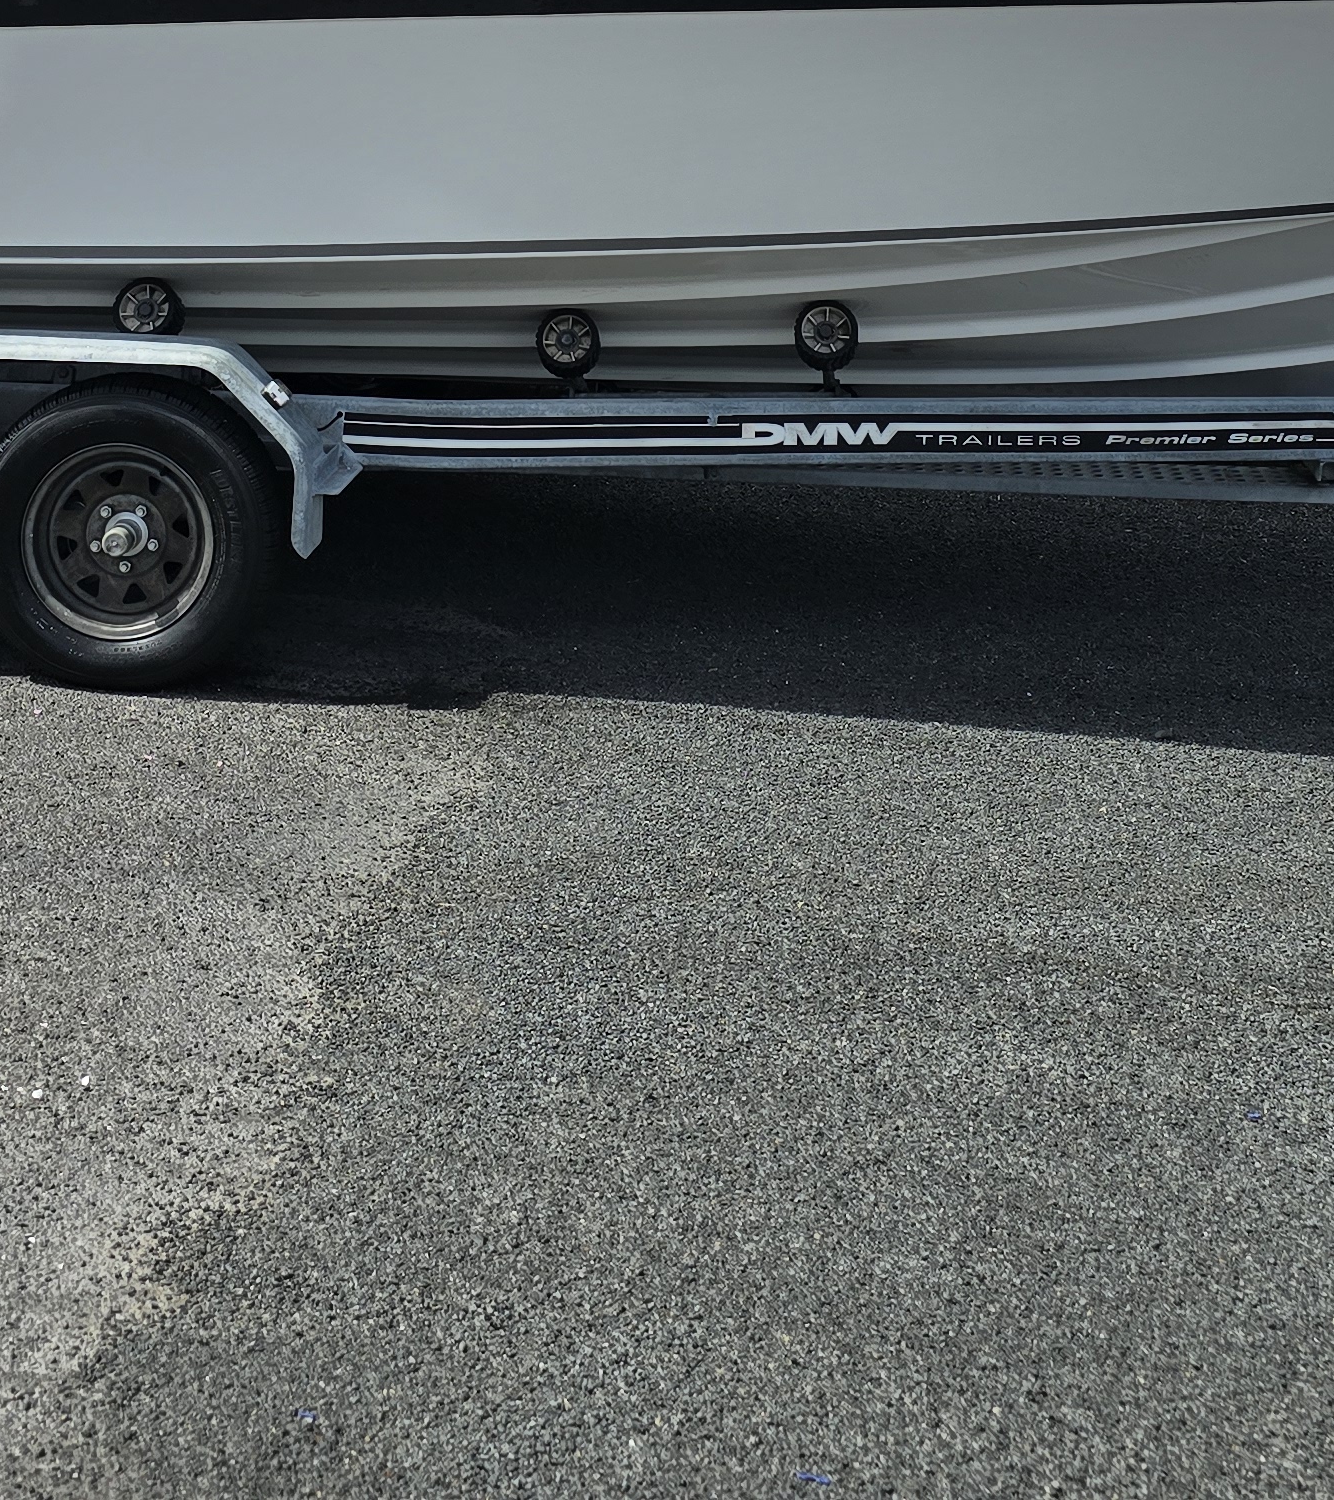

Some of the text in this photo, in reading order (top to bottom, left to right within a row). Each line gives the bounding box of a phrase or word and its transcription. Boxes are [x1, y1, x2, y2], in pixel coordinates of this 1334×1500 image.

[741, 422, 1315, 447] DMW TRAILERS Premier Series
